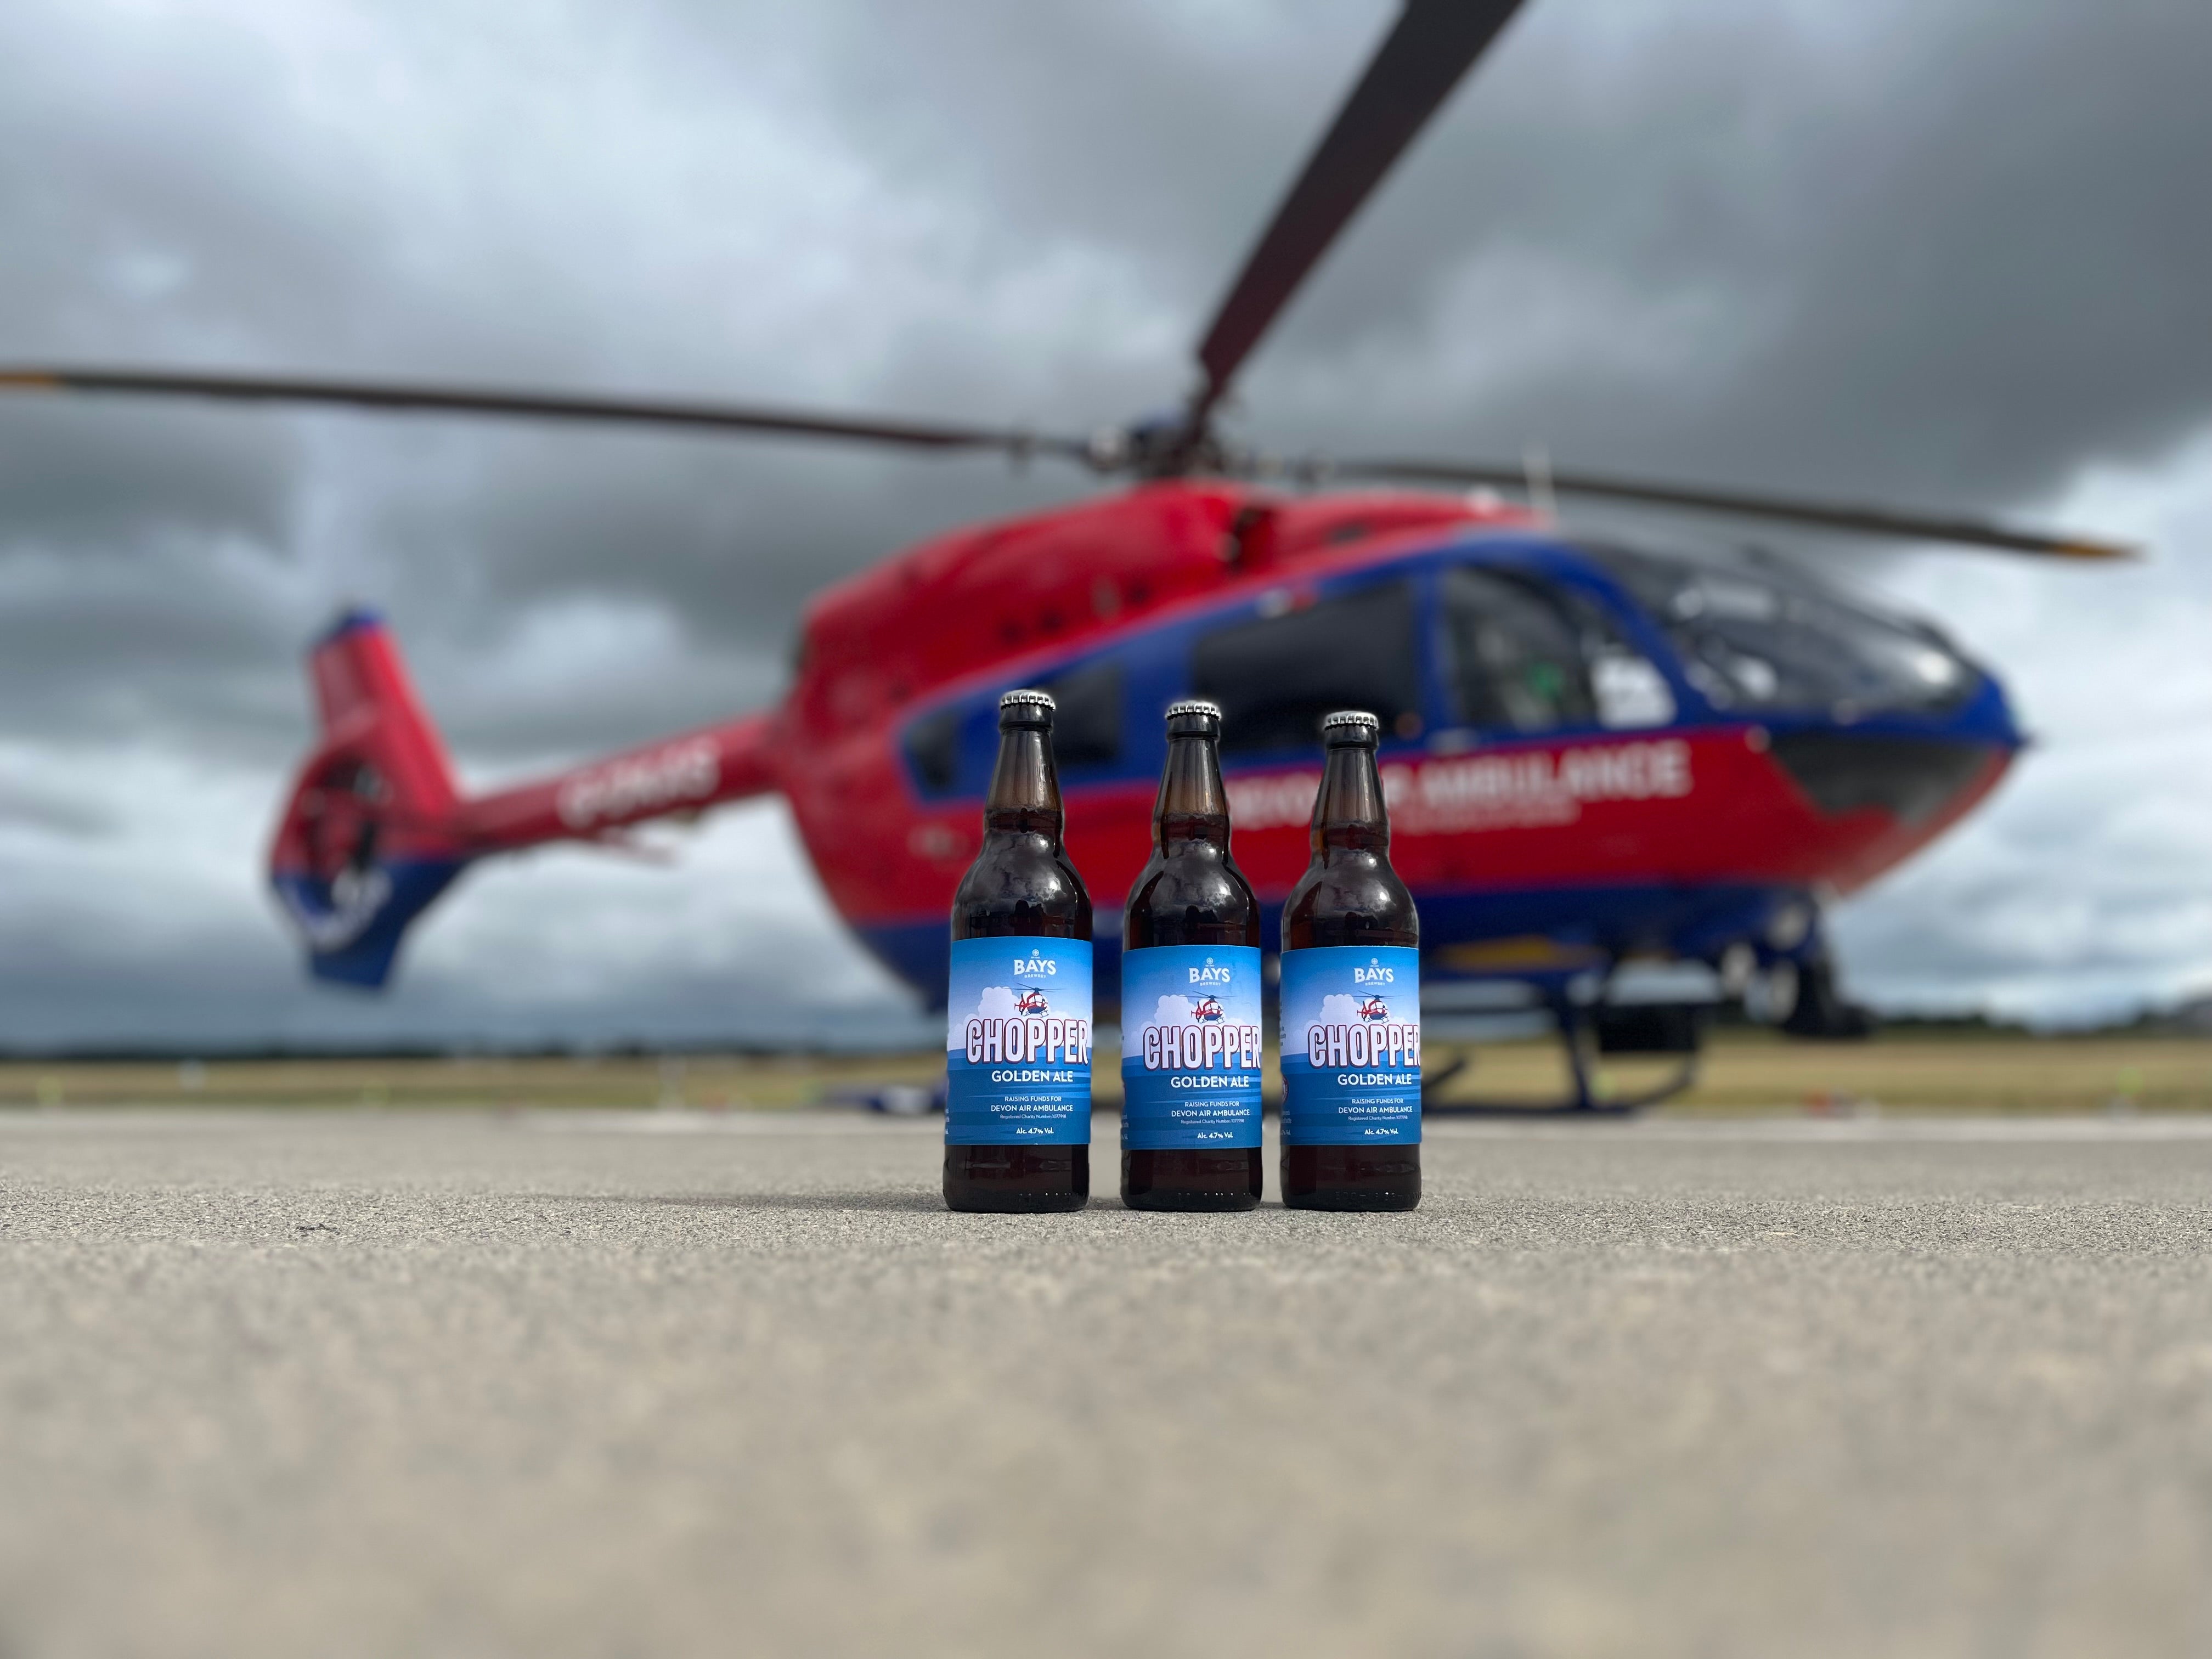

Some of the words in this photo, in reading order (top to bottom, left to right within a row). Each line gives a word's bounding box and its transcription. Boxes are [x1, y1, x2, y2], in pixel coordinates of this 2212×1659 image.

[1014, 960, 1057, 975] BAYS
[1188, 968, 1231, 983] BAYS
[1353, 968, 1394, 984] BAYS
[966, 1018, 1088, 1066] CHOPPER
[1143, 1025, 1261, 1070] CHOPPER
[991, 1070, 1049, 1082] GOLDEN
[1052, 1070, 1074, 1082] ALE
[1171, 1076, 1228, 1088] GOLDEN
[1230, 1076, 1249, 1087] ALE
[1338, 1074, 1392, 1086] GOLDEN
[1395, 1073, 1412, 1085] ALE
